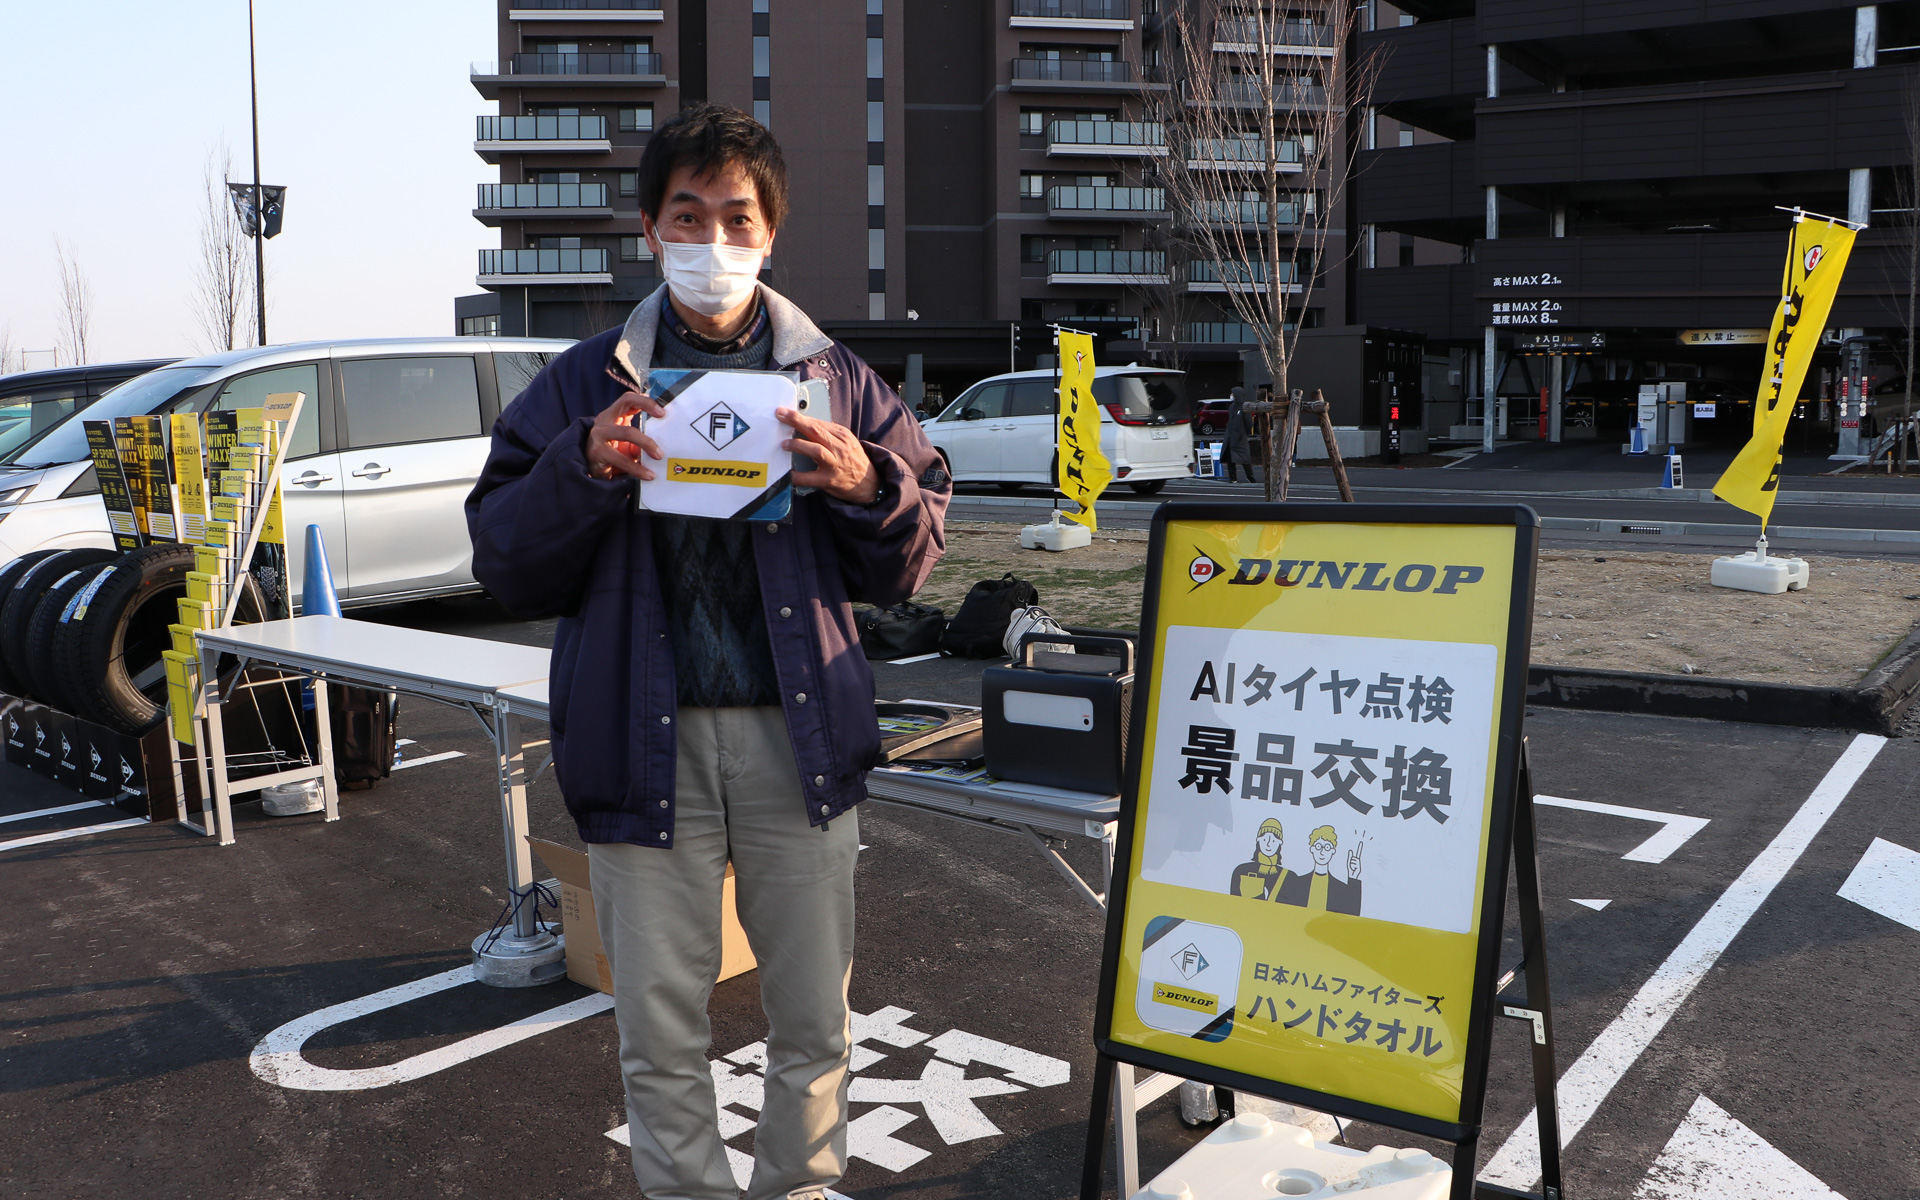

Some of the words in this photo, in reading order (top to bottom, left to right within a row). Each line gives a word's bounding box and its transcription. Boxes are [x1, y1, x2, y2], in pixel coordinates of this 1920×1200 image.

[1493, 277, 1510, 287] 高さ
[1512, 275, 1538, 286] MAX
[1492, 302, 1510, 313] 重量
[1512, 302, 1538, 312] MAX
[1492, 315, 1510, 325] 速度
[1512, 314, 1538, 324] MAX
[1540, 312, 1559, 324] 8km
[1543, 335, 1560, 343] 入口
[1691, 332, 1735, 342] 進入禁止
[116, 438, 136, 450] WINT
[207, 433, 238, 448] WINTER
[136, 444, 165, 460] VEURO
[687, 466, 761, 479] DUNLOP
[1227, 557, 1485, 595] DUNLOP
[1189, 660, 1455, 725] AIタイヤ点検
[9, 739, 24, 748] DUNLOP
[35, 748, 51, 758] DUNLOP
[61, 760, 76, 770] DUNLOP
[90, 772, 107, 783] DUNLOP
[1178, 724, 1452, 825] 景品交換
[121, 784, 141, 796] DUNLOP
[1253, 962, 1445, 1015] 日本ハムファイターズ
[1165, 991, 1214, 1007] DUNLOP
[1246, 994, 1444, 1057] ハンドタオル
